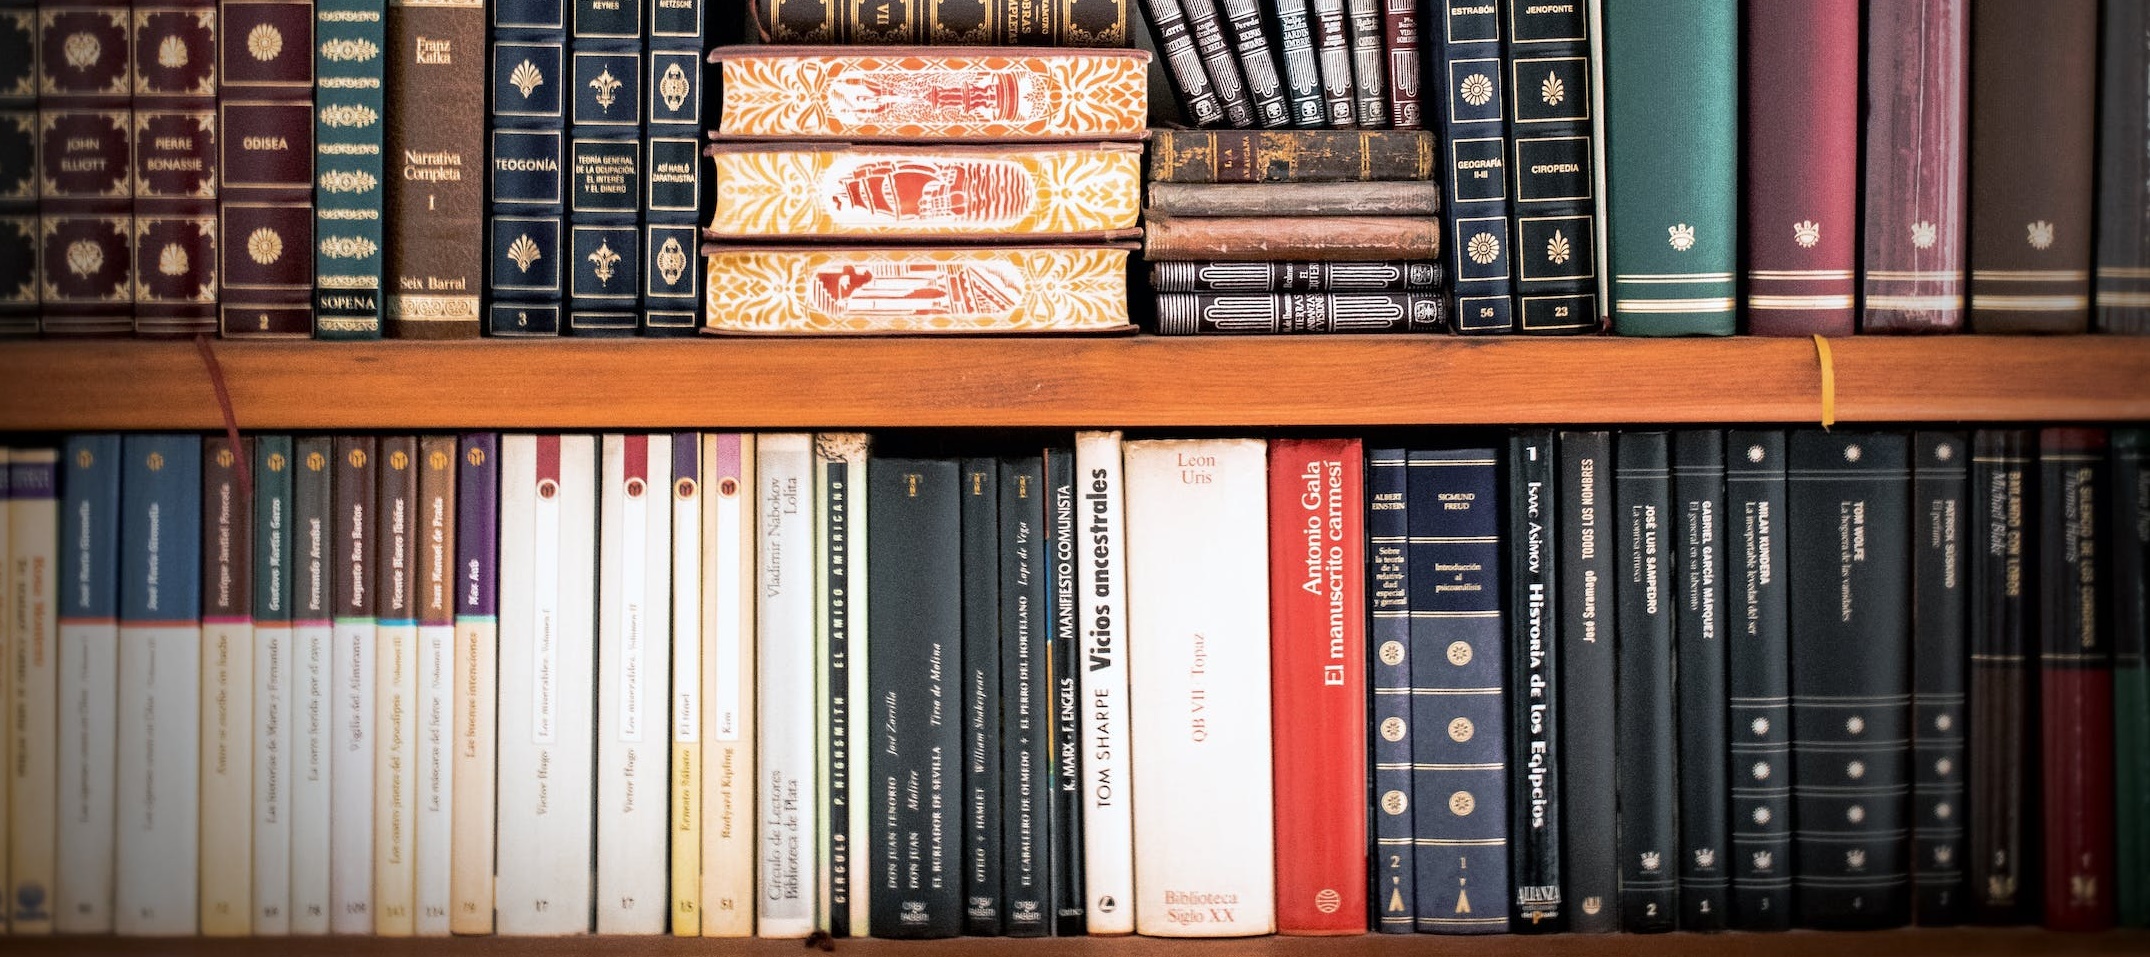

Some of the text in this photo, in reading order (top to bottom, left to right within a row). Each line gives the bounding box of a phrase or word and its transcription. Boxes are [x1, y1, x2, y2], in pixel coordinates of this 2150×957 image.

[876, 2, 890, 26] VII
[1451, 4, 1496, 16] ESTRABÓN
[1525, 4, 1575, 15] JENOFONTE
[416, 36, 451, 51] Franz
[416, 50, 451, 65] Kafka
[67, 137, 100, 152] JOHN
[155, 136, 194, 151] PIERRE
[243, 136, 289, 151] ODISEA
[404, 150, 462, 166] Narrativa
[1457, 157, 1502, 170] GEOGRAFÍA
[61, 157, 107, 172] ELLIOTT
[147, 157, 203, 172] BONASSIE
[403, 165, 461, 184] Completa
[494, 156, 558, 172] TEOGONÍA
[652, 173, 695, 184] ZARATHUSTRA
[1473, 170, 1489, 180] II-III
[1530, 163, 1580, 175] CIROPEDIA
[320, 295, 377, 310] SOPENA
[400, 275, 466, 291] Seix Barral
[258, 313, 270, 331] 2
[517, 310, 528, 327] 3
[1480, 307, 1495, 319] 56
[1554, 307, 1569, 318] 23
[783, 477, 798, 515] Lolita
[1181, 469, 1213, 485] Uris
[1373, 492, 1403, 501] ALBERT
[1437, 492, 1476, 502] SIGMUND
[767, 477, 781, 537] Nabokov
[1371, 502, 1406, 511] EINSTEIN
[1443, 502, 1471, 511] FREUD
[1581, 458, 1595, 561] TODOS LOS NOMBRES
[1944, 499, 1956, 543] PATRICK
[1301, 460, 1323, 596] Antonio Gala
[1758, 501, 1771, 586] MILAN KUNDERA
[1853, 501, 1865, 562] TOM WOLFE
[2006, 470, 2022, 597] BAILANDO CON LOBOS
[309, 517, 321, 611] Fernando Arrabal
[351, 504, 365, 608] Augusto Roa Bastos
[432, 496, 443, 610] Juan Manuel de Prada
[1016, 521, 1030, 587] Lope de Vega
[1056, 484, 1074, 640] MANIFIESTO COMUNISTA
[1085, 467, 1111, 672] Vicios ancestrales
[1434, 562, 1482, 572] Introducción
[1645, 504, 1659, 615] JOSÉ LUIS SAMPEDRO
[1702, 499, 1715, 640] GABRIEL GARCÍA MÁRQUEZ
[468, 558, 480, 606] Max Aub
[833, 481, 844, 669] EL AMIGO AMERICANO
[1322, 460, 1345, 687] El manuscrito carmesí
[1582, 570, 1598, 644] José Saramago
[466, 632, 478, 697] intenciones
[1018, 595, 1030, 730] EL PERRO DEL HORTELANO
[1190, 632, 1208, 676] Topaz
[930, 642, 942, 727] Tirso de Molina
[465, 699, 476, 738] buenas
[722, 712, 732, 734] Kim
[885, 690, 899, 756] José Zorrilla
[973, 669, 988, 774] William Shakespeare
[1061, 677, 1075, 733] F. ENGELS
[1191, 689, 1208, 743] QB VII
[1530, 704, 1546, 735] los
[833, 695, 845, 789] HIGHSMITH
[1094, 687, 1112, 809] TOM SHARPE
[1062, 742, 1075, 792] K. MARX
[721, 747, 734, 839] Rudyard Kipling
[768, 769, 782, 826] Lectores
[908, 769, 919, 811] Molière
[887, 775, 899, 889] DON JUAN TENORIO
[932, 746, 942, 888] EL BURLADOR DE SEVILLA
[975, 785, 986, 883] OTELO HAMLET
[1020, 750, 1031, 886] EL CABALLERO DE OLMEDO
[768, 829, 782, 847] de
[784, 779, 799, 900] Biblioteca de Plata
[834, 832, 846, 904] CIRCULO
[909, 831, 920, 889] DON JUAN
[1390, 855, 1401, 868] 2
[622, 897, 635, 910] 17
[1164, 889, 1240, 906] Biblioteca
[1517, 885, 1561, 905] ALIANZA
[1645, 903, 1658, 916] 2
[1166, 907, 1236, 926] Siglo XX
